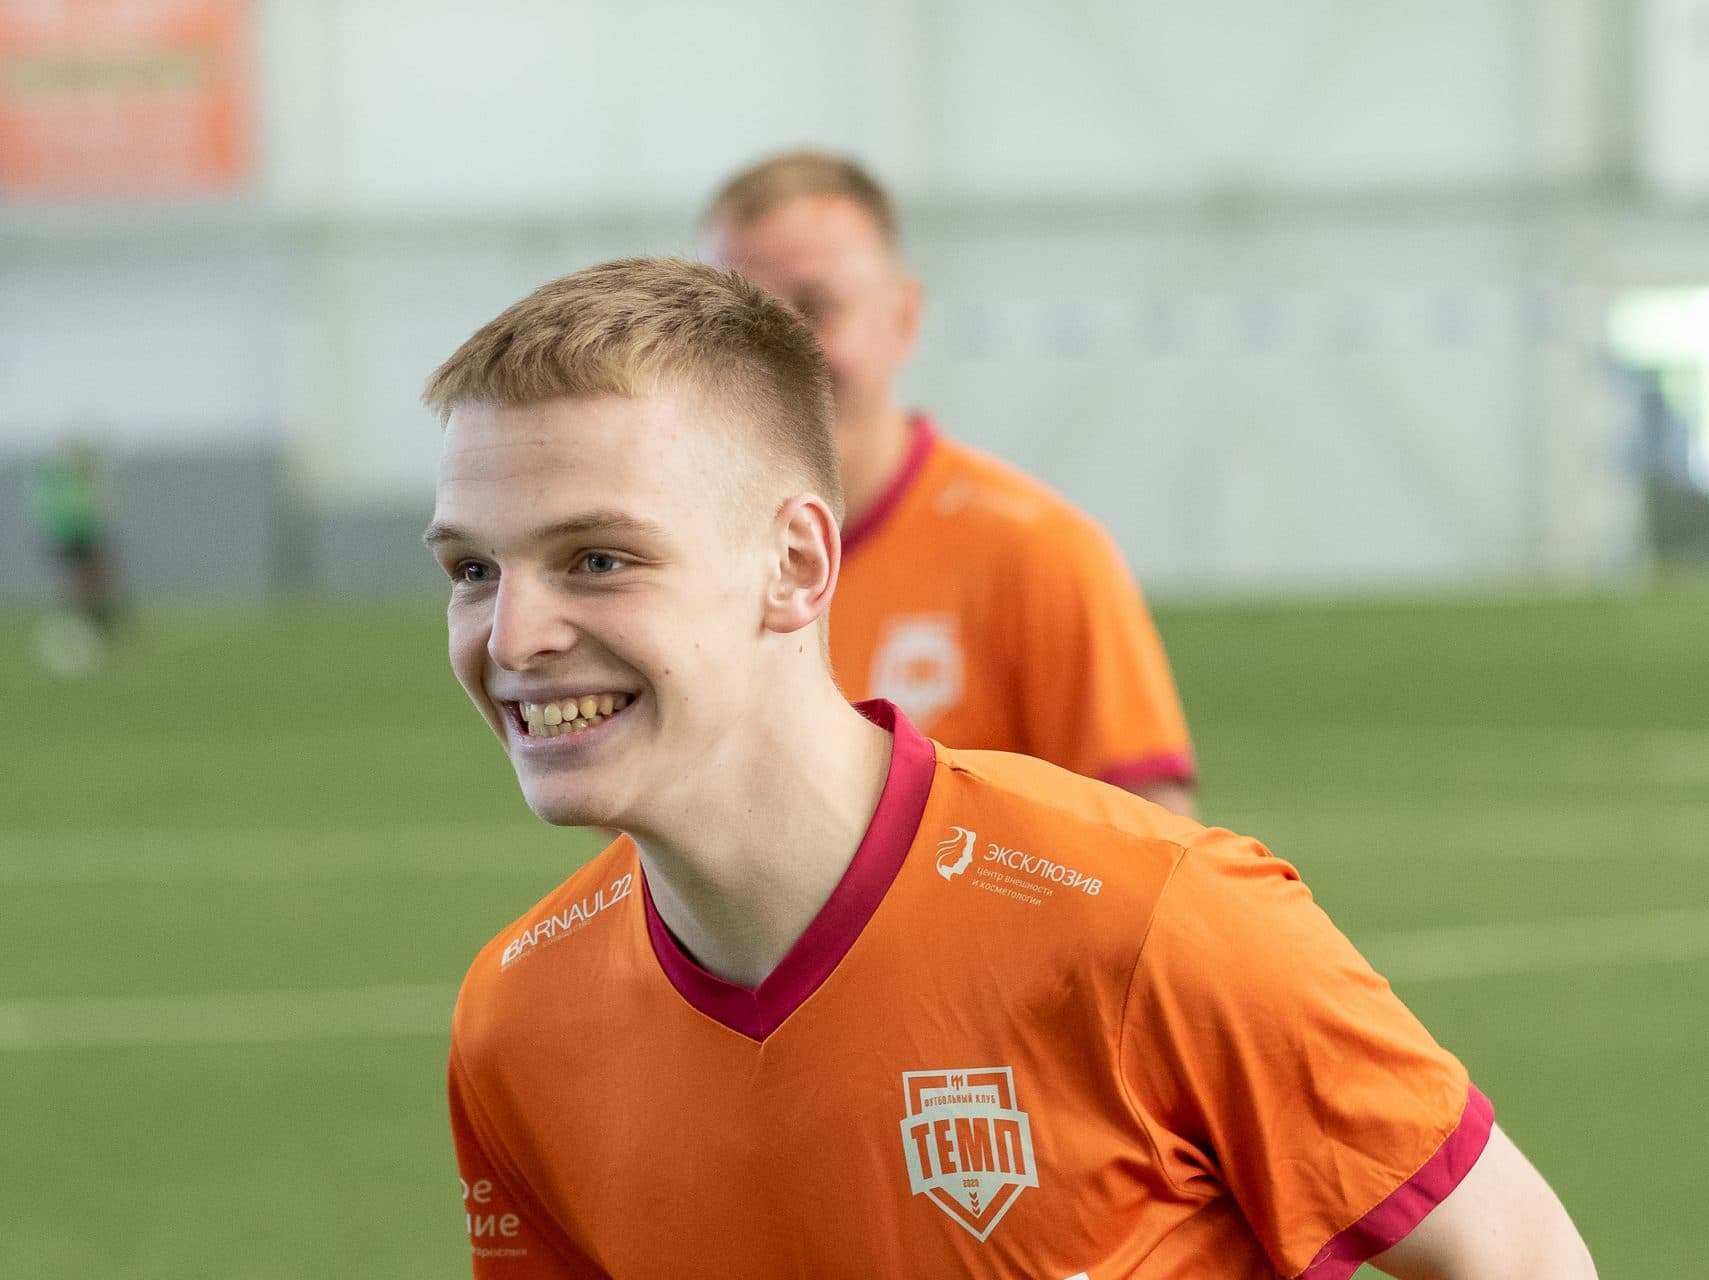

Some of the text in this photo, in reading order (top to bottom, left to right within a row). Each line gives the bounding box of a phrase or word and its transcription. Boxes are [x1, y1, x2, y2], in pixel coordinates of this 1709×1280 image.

[976, 866, 1053, 897] центр внешности
[983, 843, 1103, 896] ЭКСКЛЮЗИВ
[980, 881, 1042, 906] косметологии
[501, 873, 632, 966] BARNAUL22
[924, 1092, 996, 1107] ФУТБОЛЬНЫЙ КЛУБ
[910, 1117, 1027, 1181] ТЕМП
[962, 1179, 980, 1188] 2020
